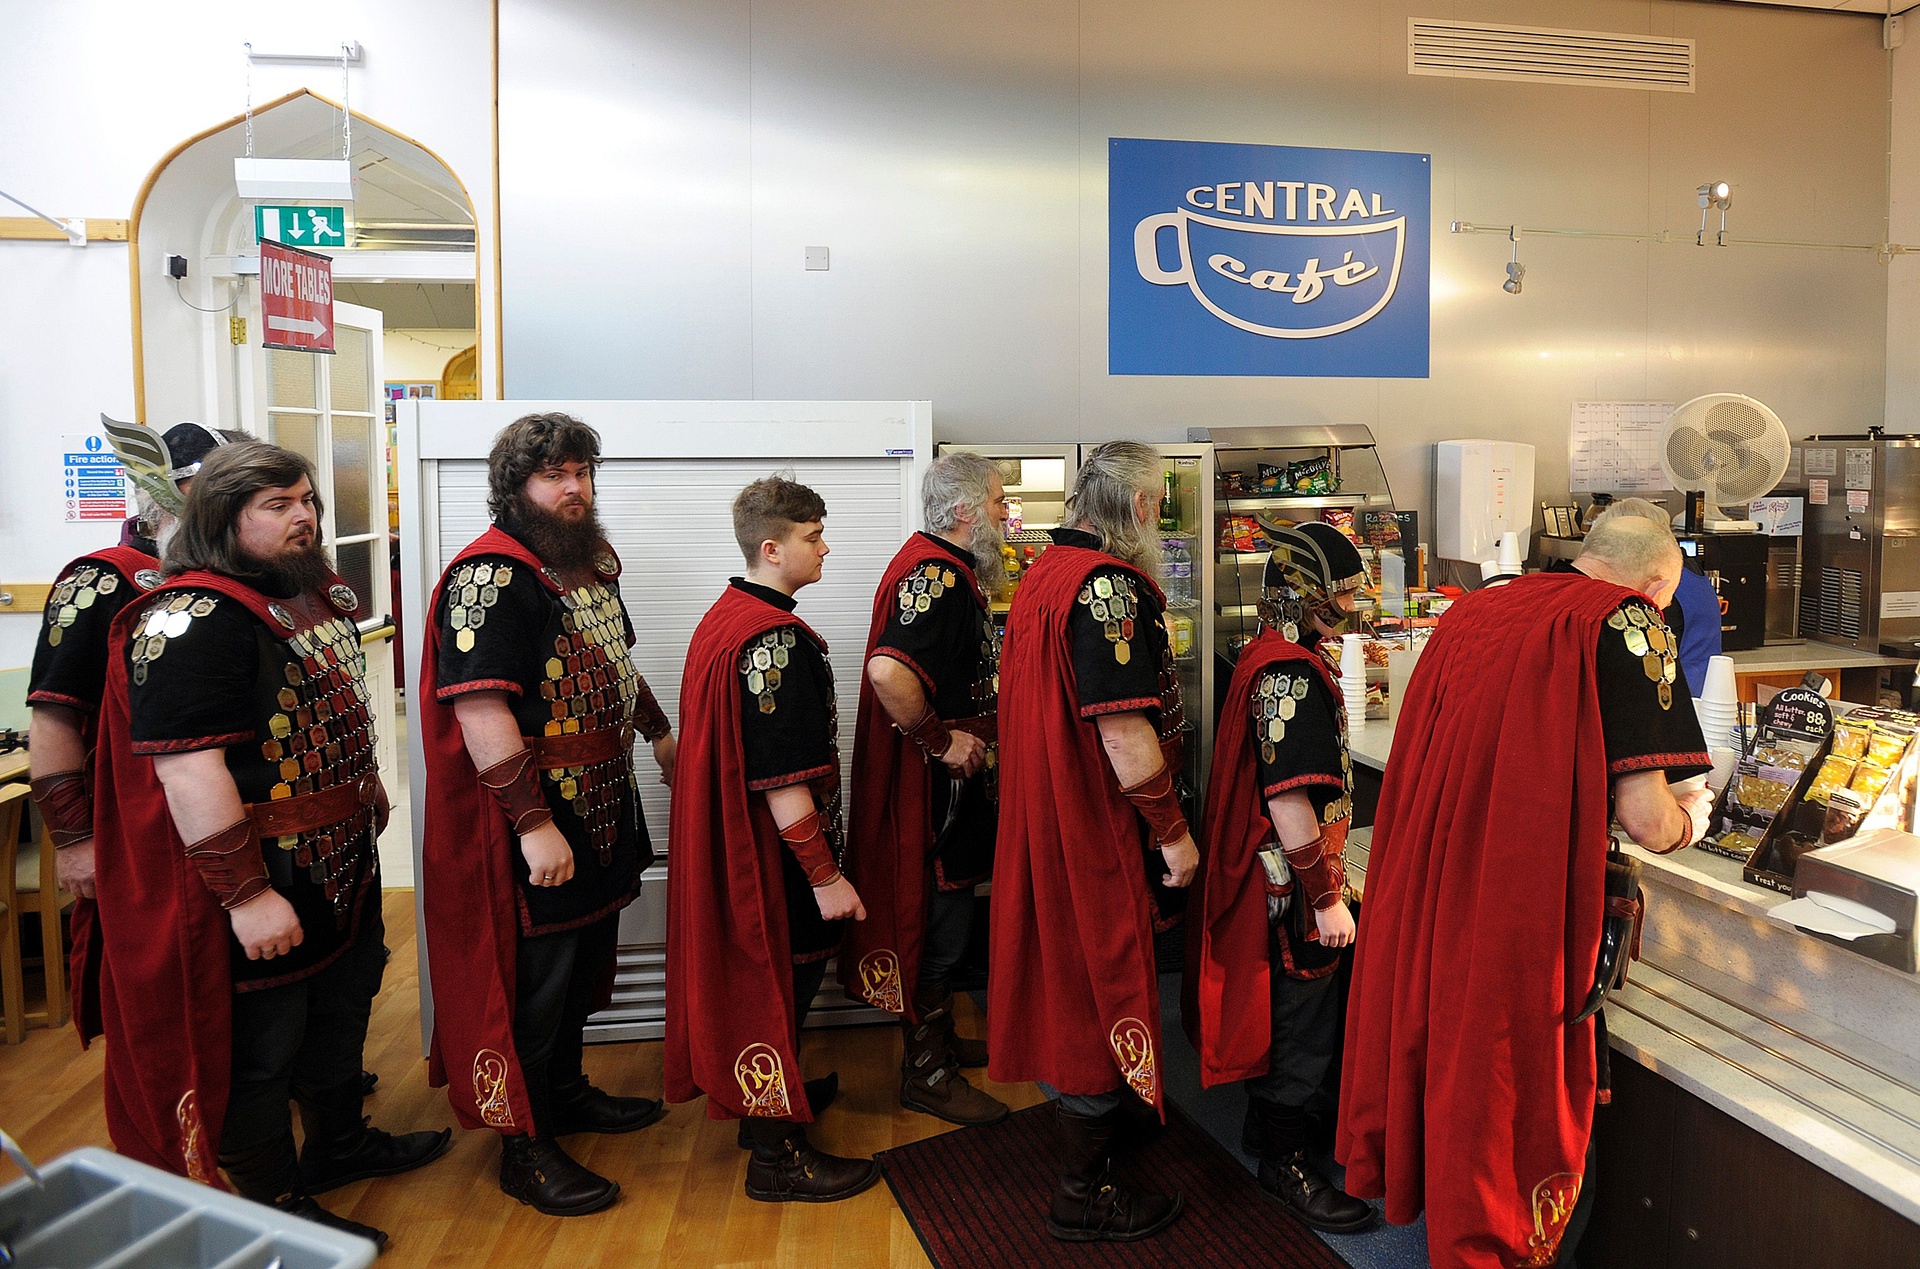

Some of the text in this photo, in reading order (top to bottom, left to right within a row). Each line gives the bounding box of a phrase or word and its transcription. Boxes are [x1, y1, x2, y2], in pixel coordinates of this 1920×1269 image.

[1185, 181, 1396, 221] CENTRAL
[263, 256, 331, 306] MORE TABLES
[69, 455, 89, 463] Fire
[1365, 513, 1411, 524] Razzes
[1781, 692, 1826, 709] Cookies
[1775, 703, 1784, 712] All
[1774, 712, 1795, 722] soft &
[1773, 719, 1792, 729] chewy
[1805, 725, 1824, 734] each
[1730, 853, 1748, 861] cook
[1753, 874, 1792, 892] Treat you
